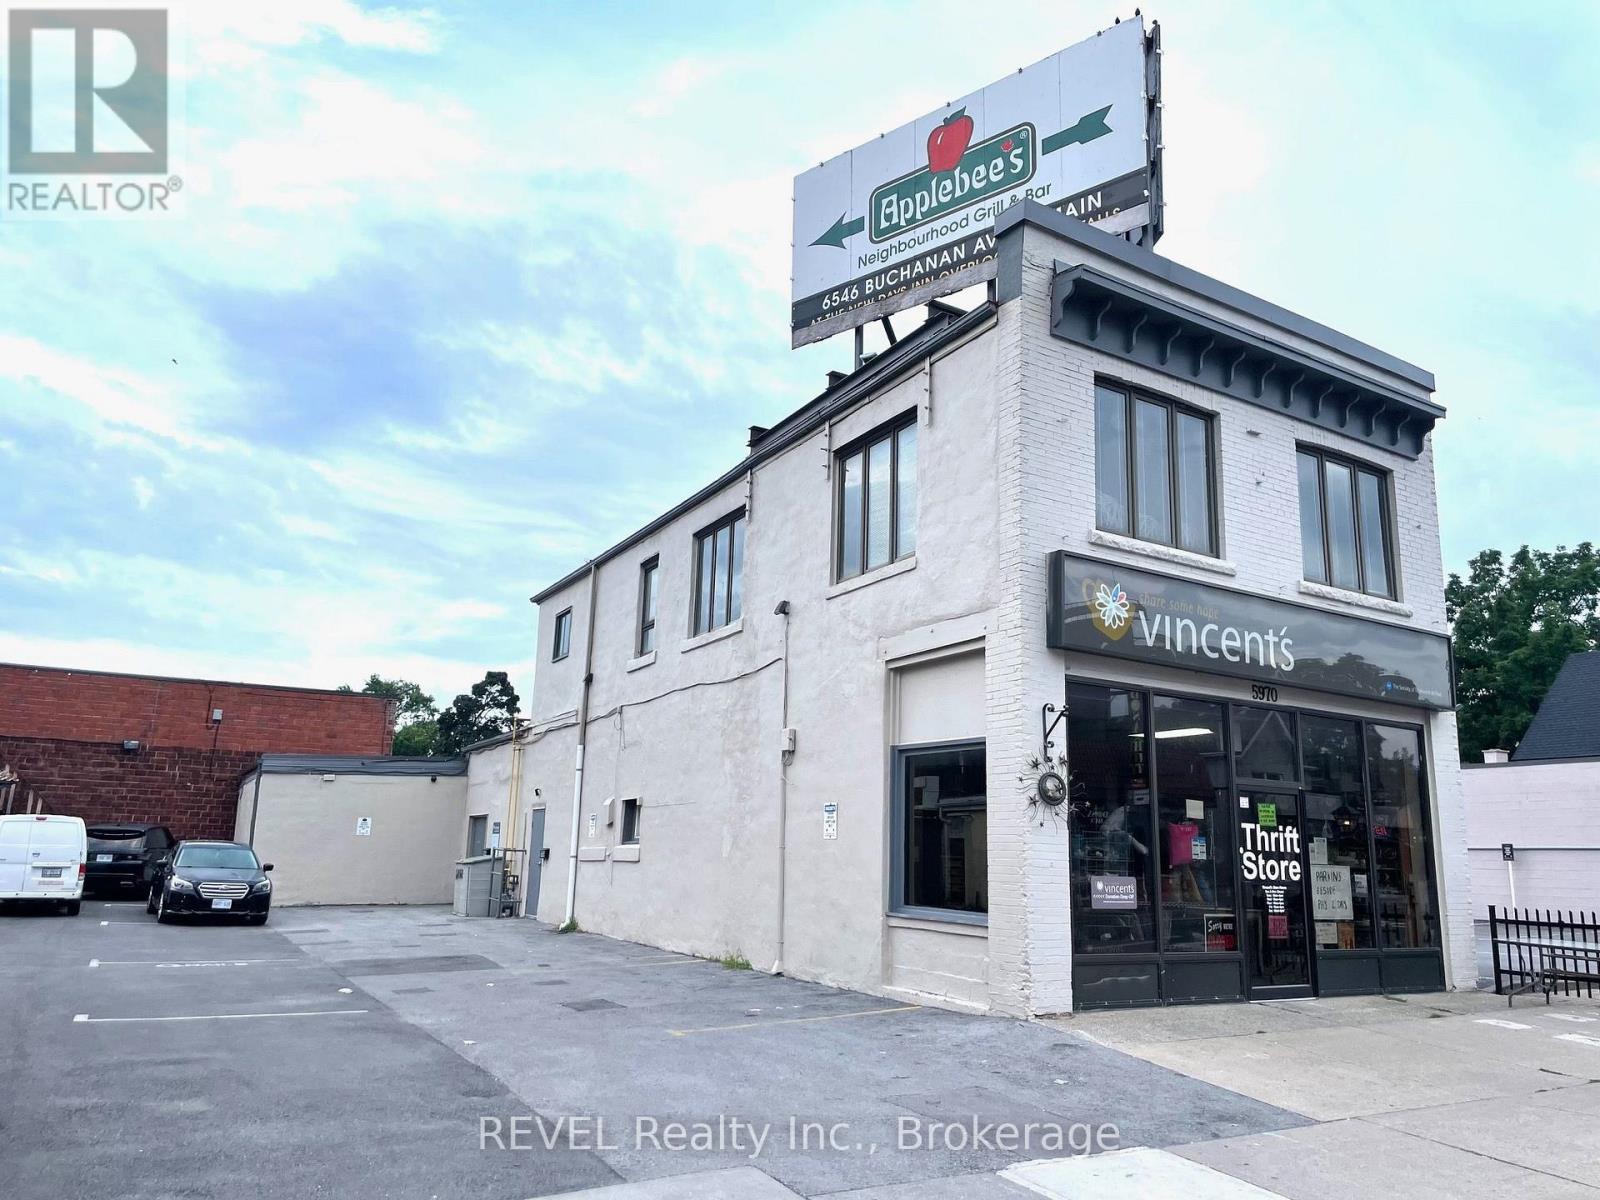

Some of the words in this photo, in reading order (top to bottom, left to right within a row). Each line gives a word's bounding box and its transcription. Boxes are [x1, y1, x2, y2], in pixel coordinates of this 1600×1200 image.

[857, 213, 969, 269] Neighbourhood
[973, 199, 1004, 222] Grill
[1025, 183, 1052, 201] Bar
[822, 284, 859, 310] 6546
[865, 243, 966, 294] BUCHANAN
[1169, 600, 1194, 613] some
[1252, 684, 1278, 702] 5970
[1241, 822, 1300, 853] Thrift
[1242, 851, 1301, 880] Store
